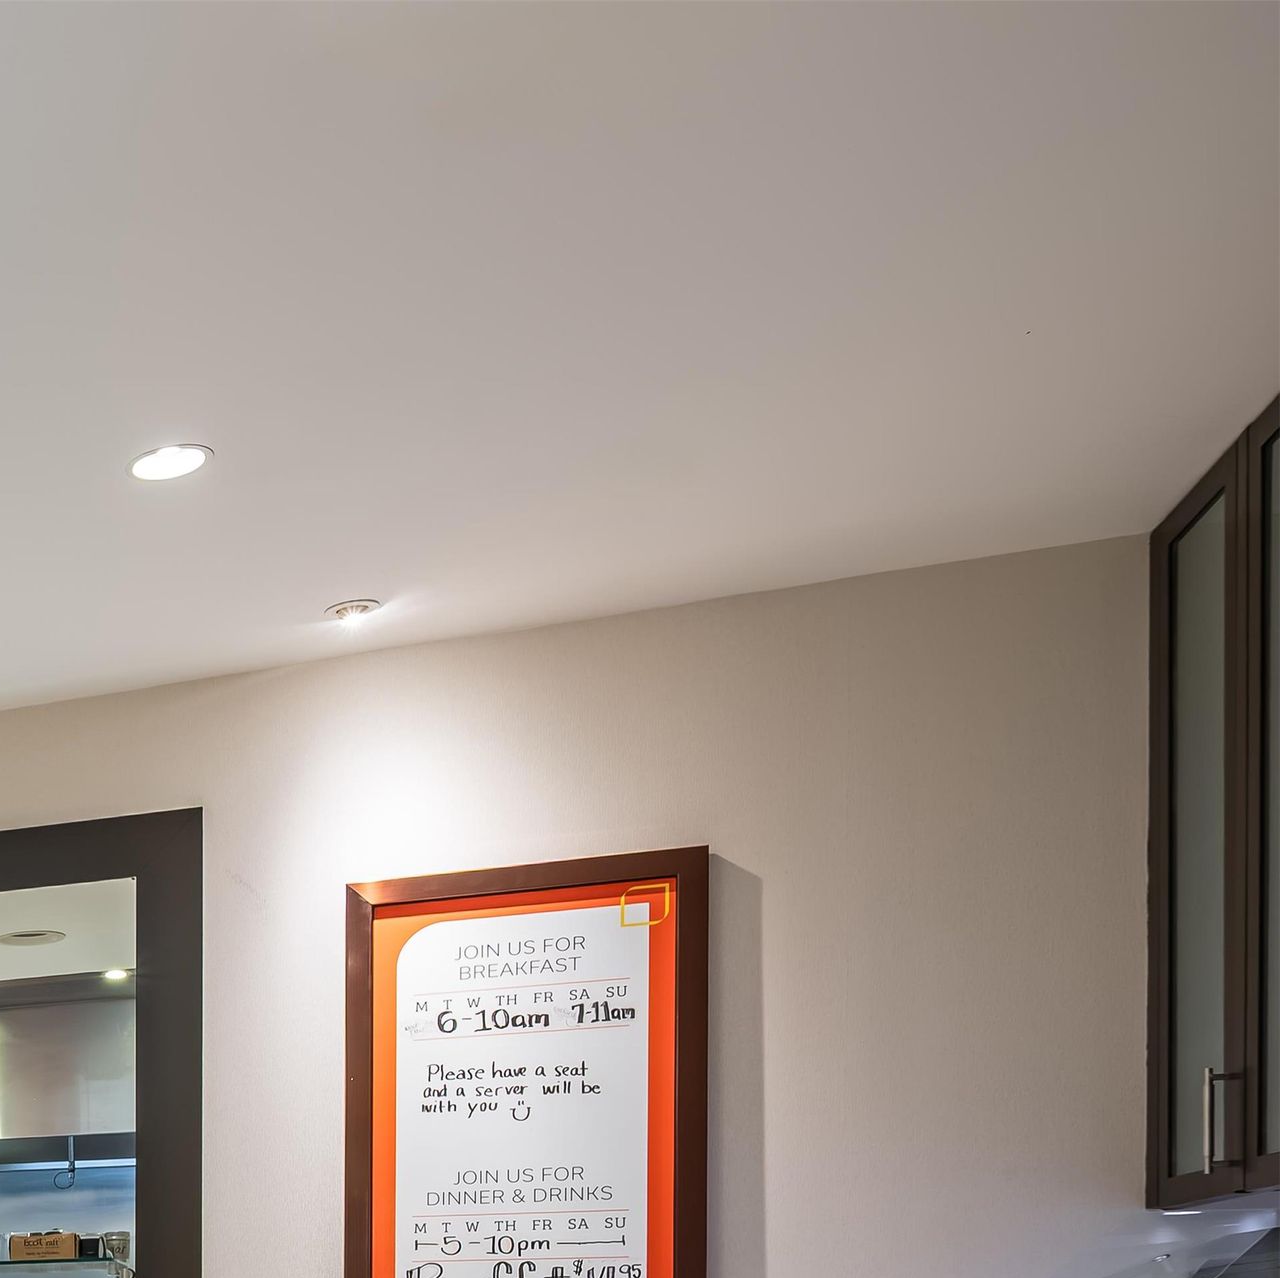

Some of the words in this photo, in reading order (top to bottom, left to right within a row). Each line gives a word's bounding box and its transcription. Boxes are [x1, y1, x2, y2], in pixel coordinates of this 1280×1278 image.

[455, 944, 500, 961] JOIN
[508, 941, 535, 957] US
[543, 935, 586, 953] FOR
[459, 956, 582, 980] BREAKFAST
[416, 1001, 428, 1012] M
[443, 999, 453, 1010] T
[467, 997, 480, 1008] W
[496, 994, 518, 1006] TH
[534, 991, 554, 1003] FR
[569, 988, 590, 1001] SA
[606, 985, 627, 998] SU
[571, 1001, 636, 1024] 7-11am
[428, 1064, 485, 1082] Please
[492, 1061, 527, 1078] have
[535, 1065, 546, 1077] a
[554, 1061, 588, 1077] seat
[423, 1083, 447, 1098] and
[457, 1085, 466, 1097] a
[476, 1084, 529, 1097] server
[542, 1080, 571, 1094] will
[582, 1081, 601, 1094] be
[422, 1099, 457, 1113] with
[468, 1100, 498, 1117] you
[453, 1170, 498, 1185] JOIN
[507, 1168, 534, 1183] US
[542, 1166, 585, 1181] FOR
[426, 1189, 504, 1206] DINNER
[512, 1188, 525, 1203] &
[533, 1186, 613, 1202] DRINKS
[414, 1223, 427, 1234] M
[442, 1222, 452, 1233] T
[466, 1221, 480, 1232] W
[495, 1220, 516, 1231] TH
[532, 1219, 553, 1230] FR
[568, 1218, 589, 1229] SA
[604, 1217, 626, 1228] SU
